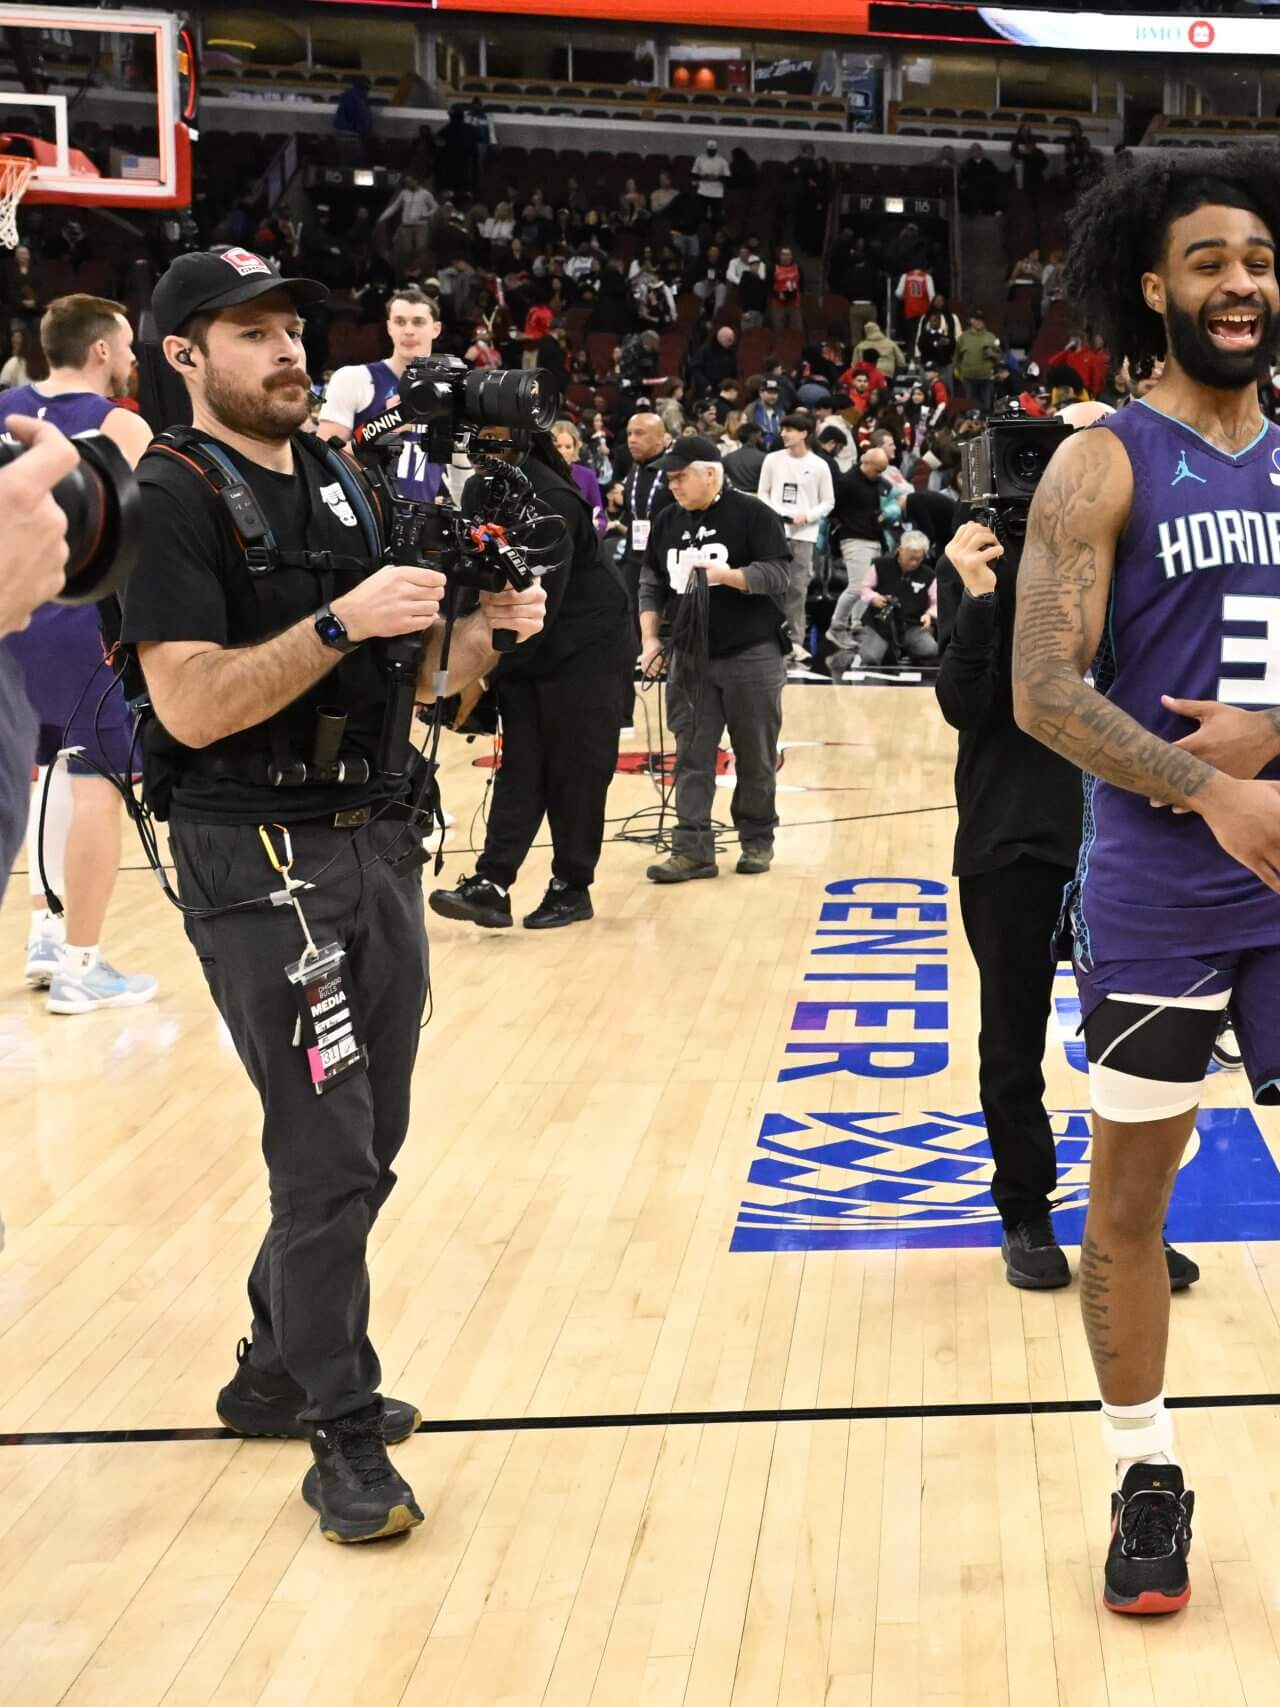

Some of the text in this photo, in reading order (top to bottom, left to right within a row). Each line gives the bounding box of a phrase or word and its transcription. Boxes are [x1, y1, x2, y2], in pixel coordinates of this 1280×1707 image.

[1135, 24, 1182, 40] BMO
[361, 409, 403, 441] RONIN
[318, 976, 342, 993] CHICAGO
[777, 877, 949, 1083] CENTER
[319, 985, 338, 999] BULLS
[310, 990, 347, 1018] MEDIA
